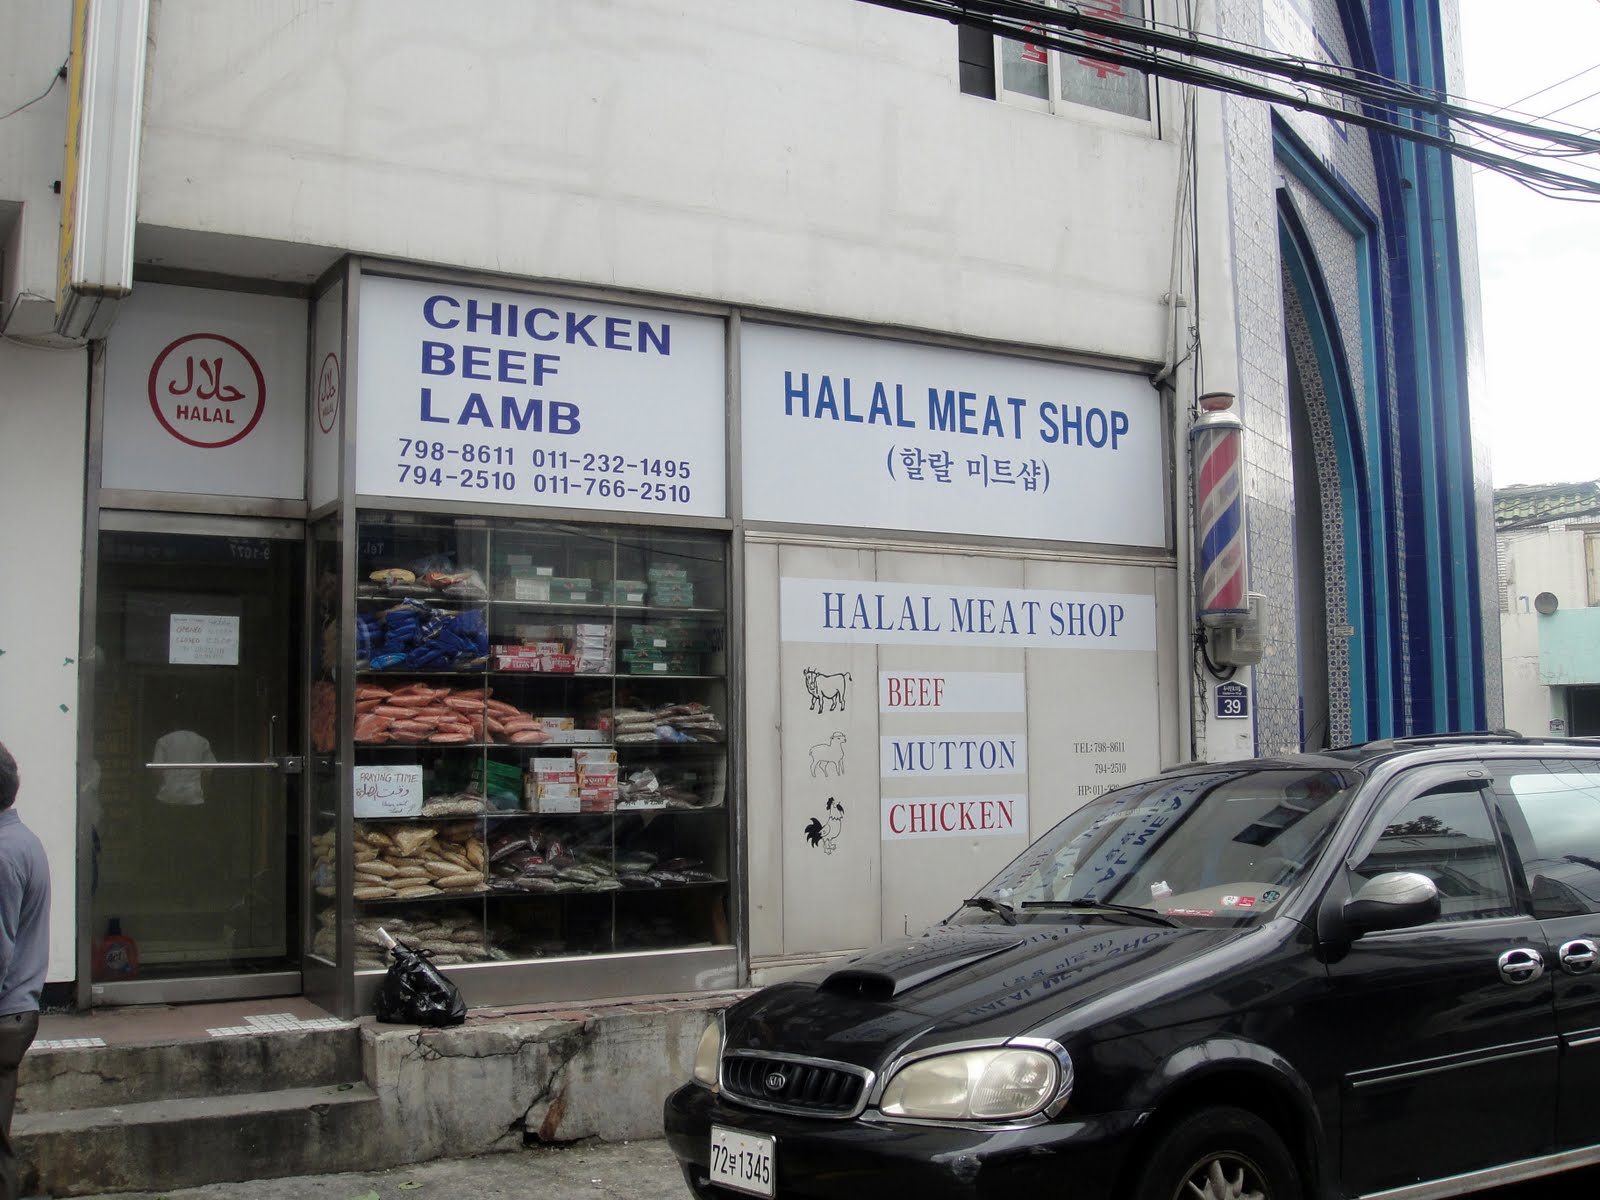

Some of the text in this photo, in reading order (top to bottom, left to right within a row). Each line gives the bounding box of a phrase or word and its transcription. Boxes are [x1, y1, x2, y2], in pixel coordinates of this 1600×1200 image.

[424, 294, 670, 356] CHICKEN
[169, 355, 246, 402] حلال
[421, 340, 560, 387] BEEF
[176, 404, 235, 424] HALAL
[421, 387, 581, 435] LAMB
[784, 370, 1129, 451] HALAL MEAT SHOP
[399, 437, 691, 480] 798-8611 011-232-1495
[886, 444, 1050, 495] (할랄 미트샵)
[397, 463, 691, 504] 794-2510 011-766-2510
[822, 591, 1125, 637] HALAL MEAT SHOP
[887, 677, 946, 707] BEEF
[1224, 699, 1241, 714] 39
[891, 740, 1015, 771] MUTTON
[1094, 762, 1127, 774] 794-2510
[360, 772, 418, 783] PRAYING TIME
[889, 800, 1013, 834] CHICKEN
